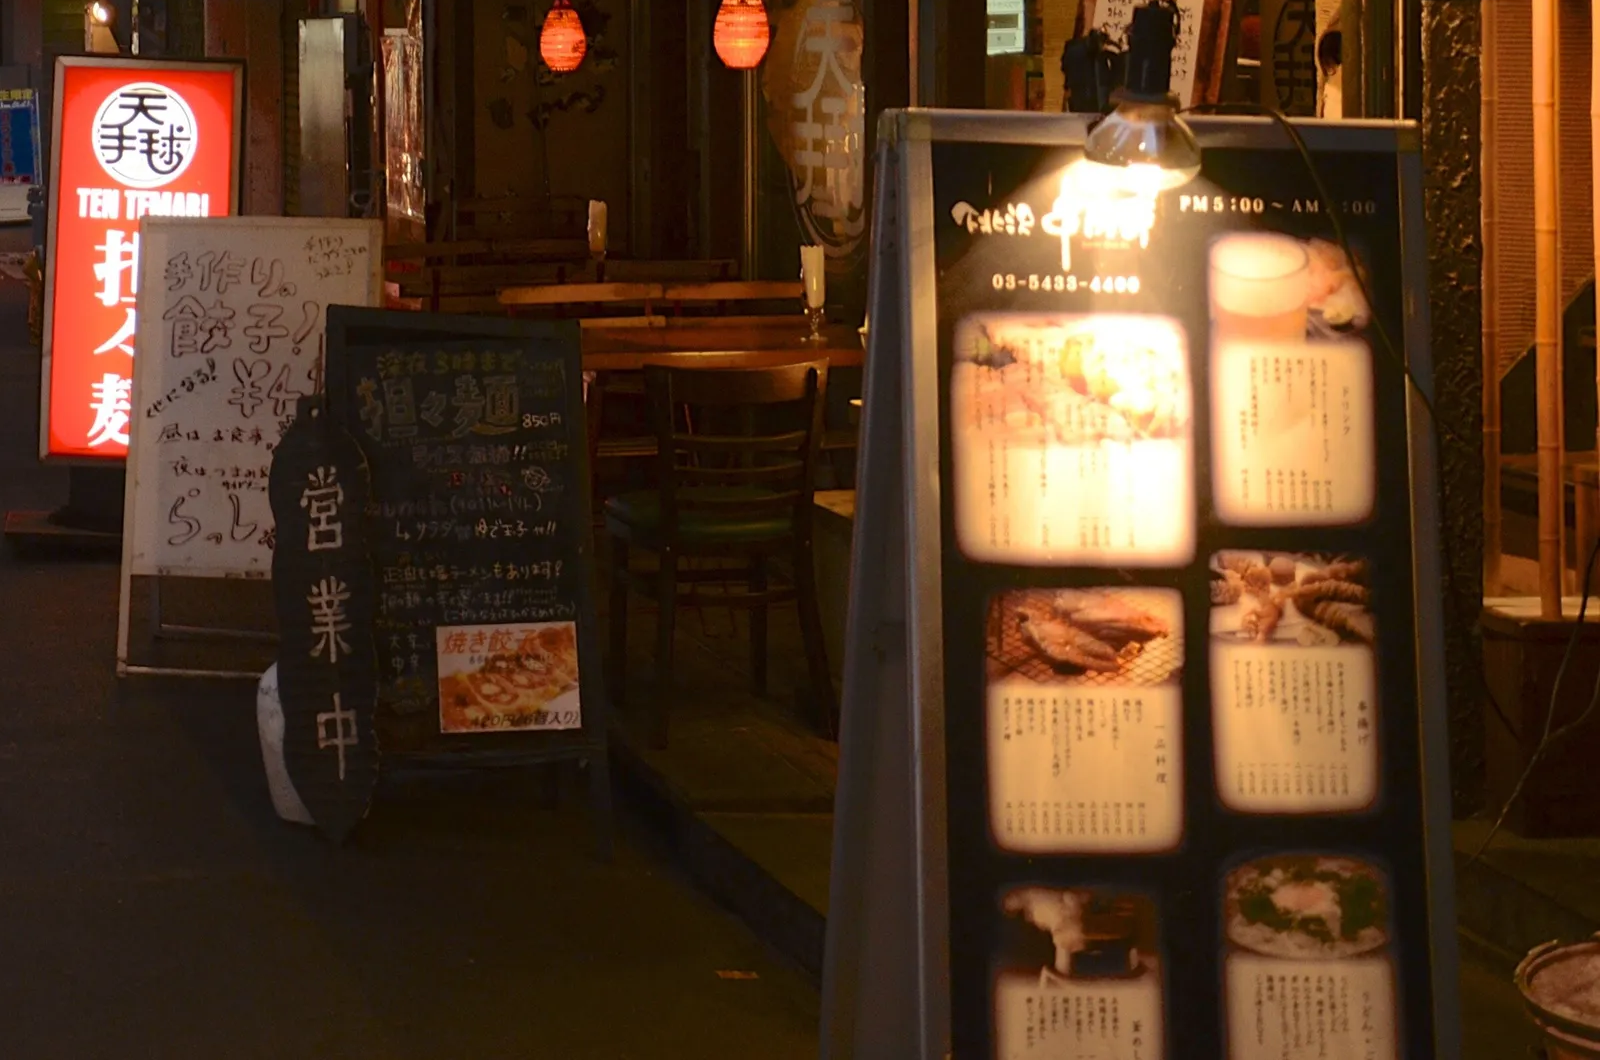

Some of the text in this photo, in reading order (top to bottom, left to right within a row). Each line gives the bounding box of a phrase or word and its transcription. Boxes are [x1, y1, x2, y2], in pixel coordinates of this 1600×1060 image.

[76, 188, 210, 219] TEN TEMARI
[162, 294, 321, 358] 餃子!
[521, 411, 562, 429] 850円
[299, 465, 363, 782] 営業中
